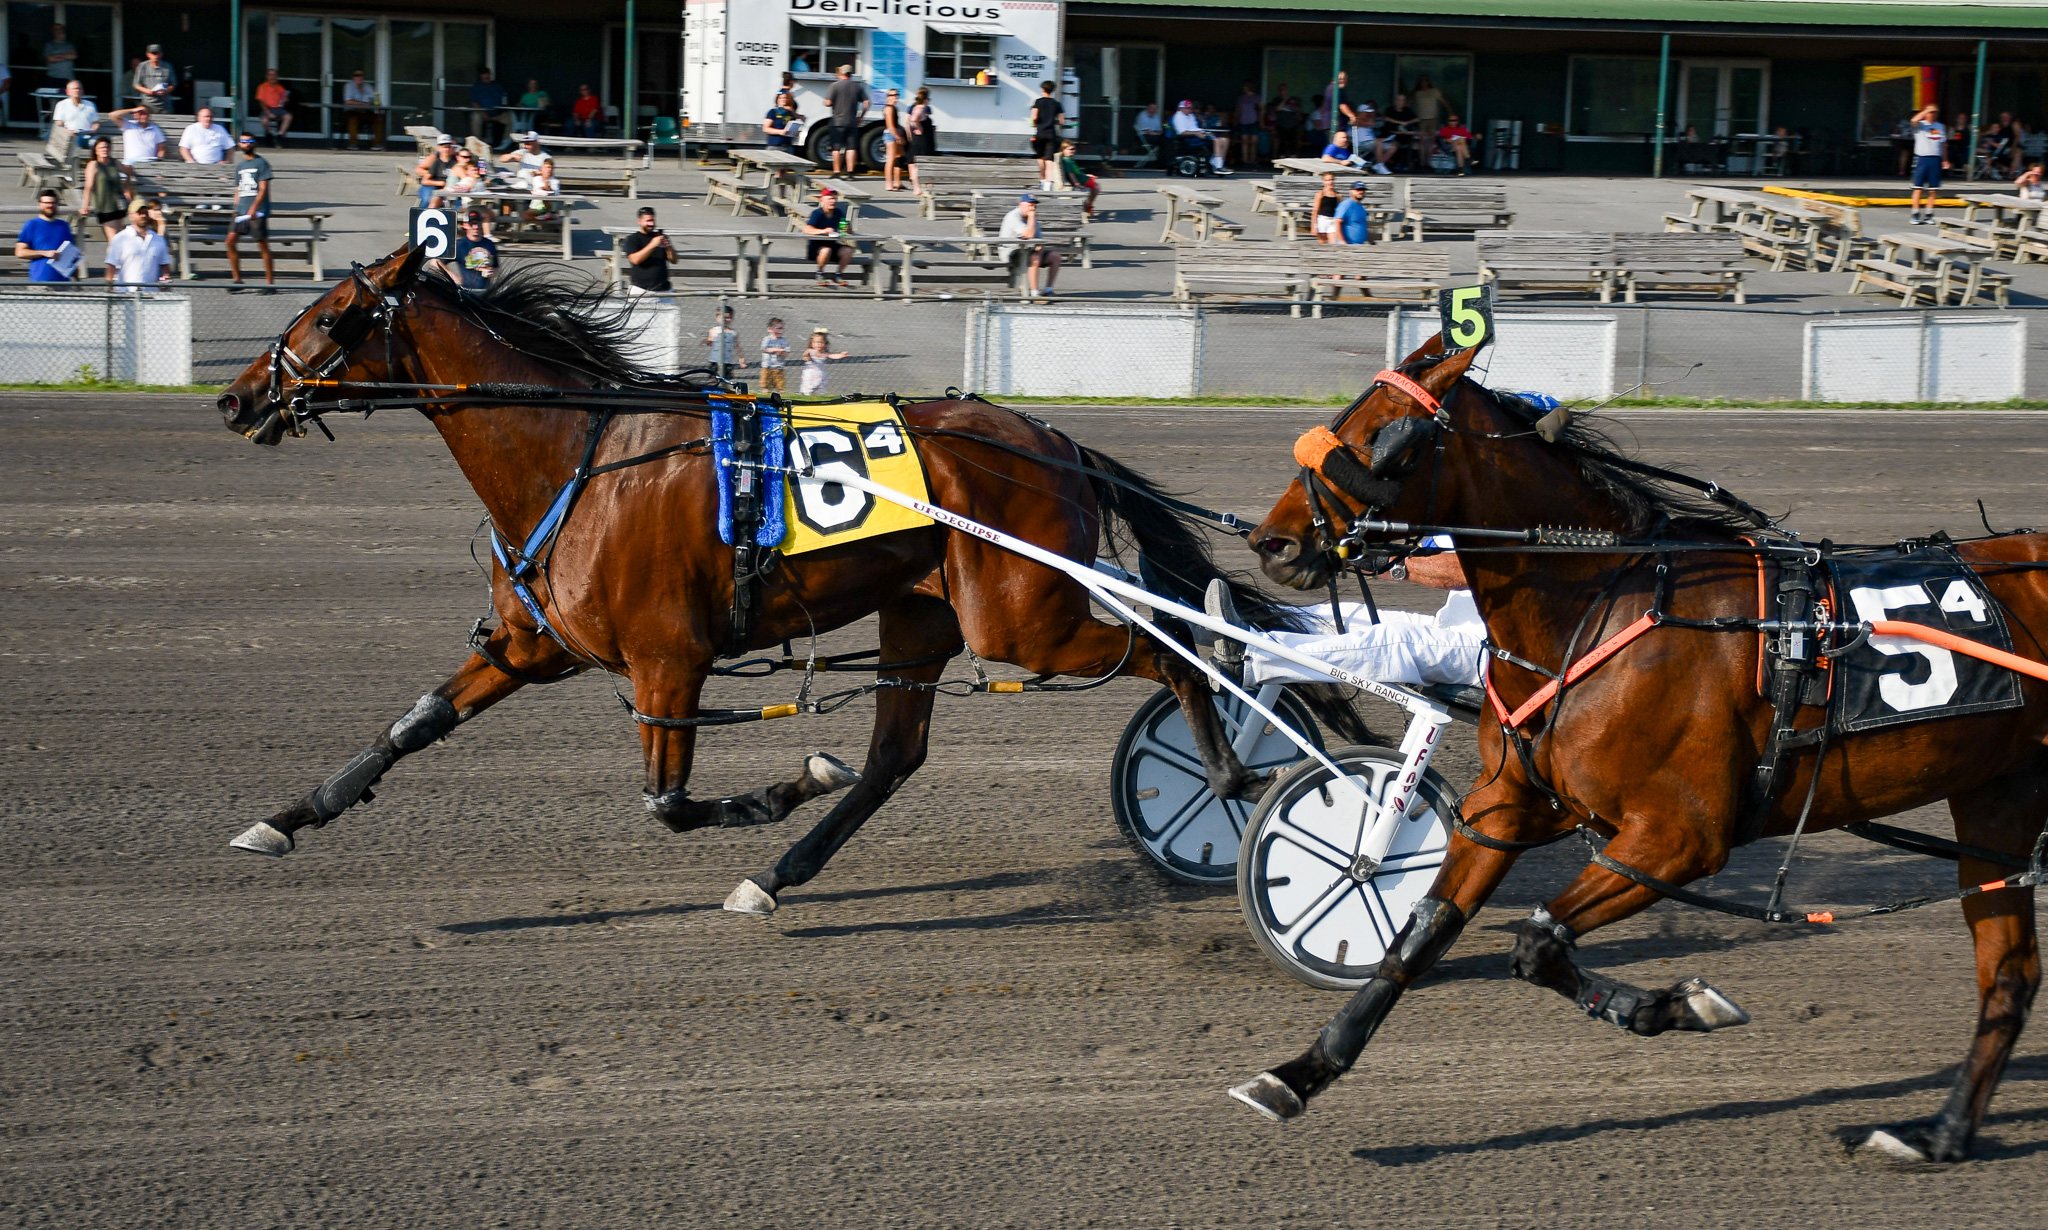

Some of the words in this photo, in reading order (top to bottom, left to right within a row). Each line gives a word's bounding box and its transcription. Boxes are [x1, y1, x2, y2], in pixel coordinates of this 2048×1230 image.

[791, 0, 1000, 19] Deli-licious
[735, 41, 780, 53] ORDER
[1004, 54, 1030, 62] PICK
[739, 56, 774, 67] HERE
[1006, 62, 1045, 70] ORDER
[417, 209, 448, 258] 6
[1451, 286, 1486, 348] 5
[1394, 375, 1428, 401] RACING
[789, 430, 866, 528] 6
[864, 422, 903, 454] 4
[1849, 584, 1959, 712] 5
[1939, 579, 1987, 623] 4
[1329, 667, 1348, 681] BIG
[1350, 675, 1372, 689] SKY
[1373, 684, 1410, 705] RANCH
